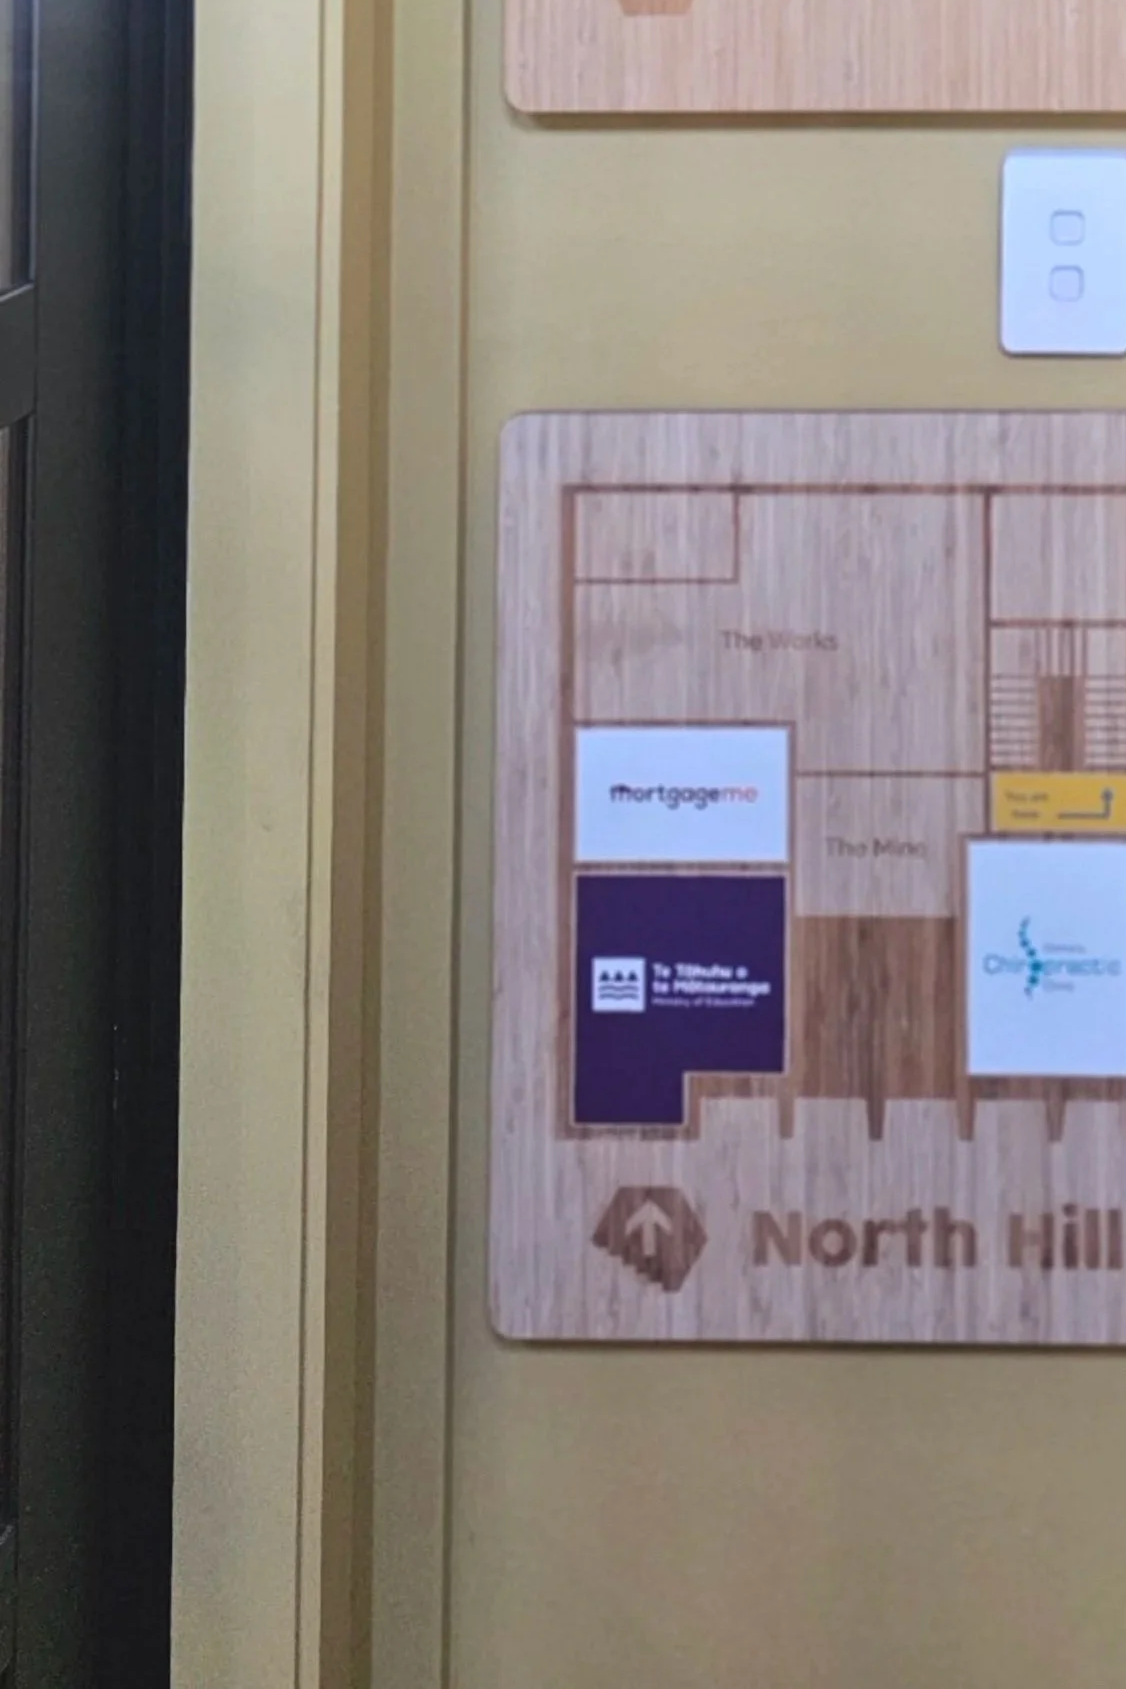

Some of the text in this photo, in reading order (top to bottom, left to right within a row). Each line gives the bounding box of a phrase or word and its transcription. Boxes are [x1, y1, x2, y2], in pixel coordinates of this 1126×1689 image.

[609, 783, 759, 811] mortgageme
[825, 835, 867, 859] The
[752, 1203, 1125, 1271] North Hill
